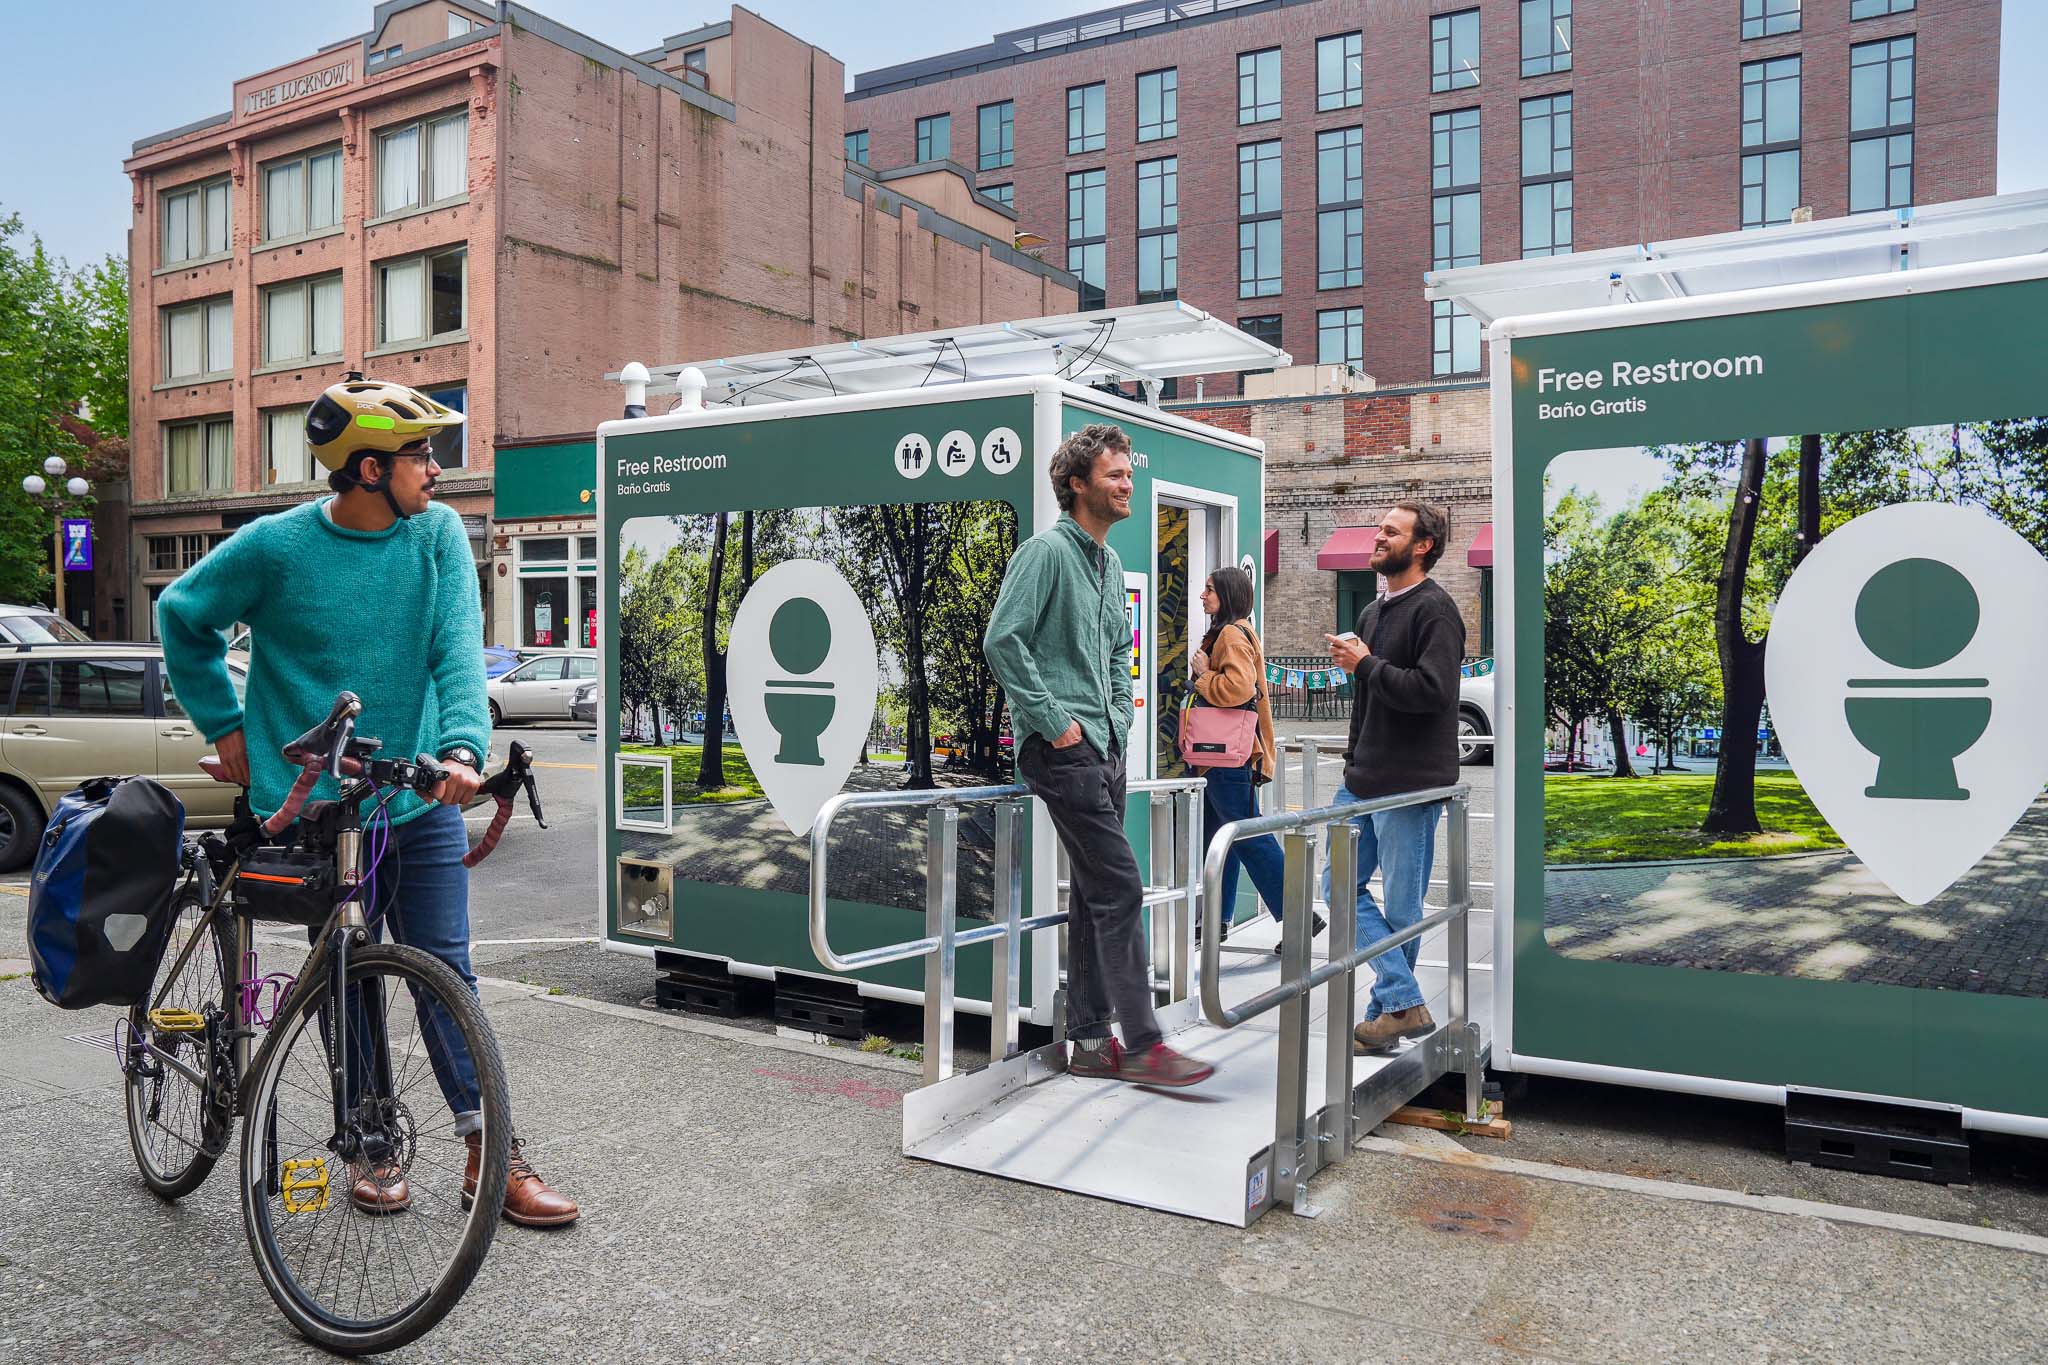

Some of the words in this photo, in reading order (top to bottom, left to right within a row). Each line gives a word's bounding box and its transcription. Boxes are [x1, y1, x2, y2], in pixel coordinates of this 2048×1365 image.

[251, 88, 276, 111] THE
[281, 65, 345, 101] LUCKNOW
[1538, 367, 1603, 393] Free
[1612, 354, 1763, 387] Restroom
[1538, 402, 1586, 420] Baño
[1590, 396, 1647, 416] Gratis
[617, 459, 650, 477] Free
[653, 454, 727, 474] Restroom
[617, 483, 641, 495] Baño
[642, 480, 671, 494] Gratis
